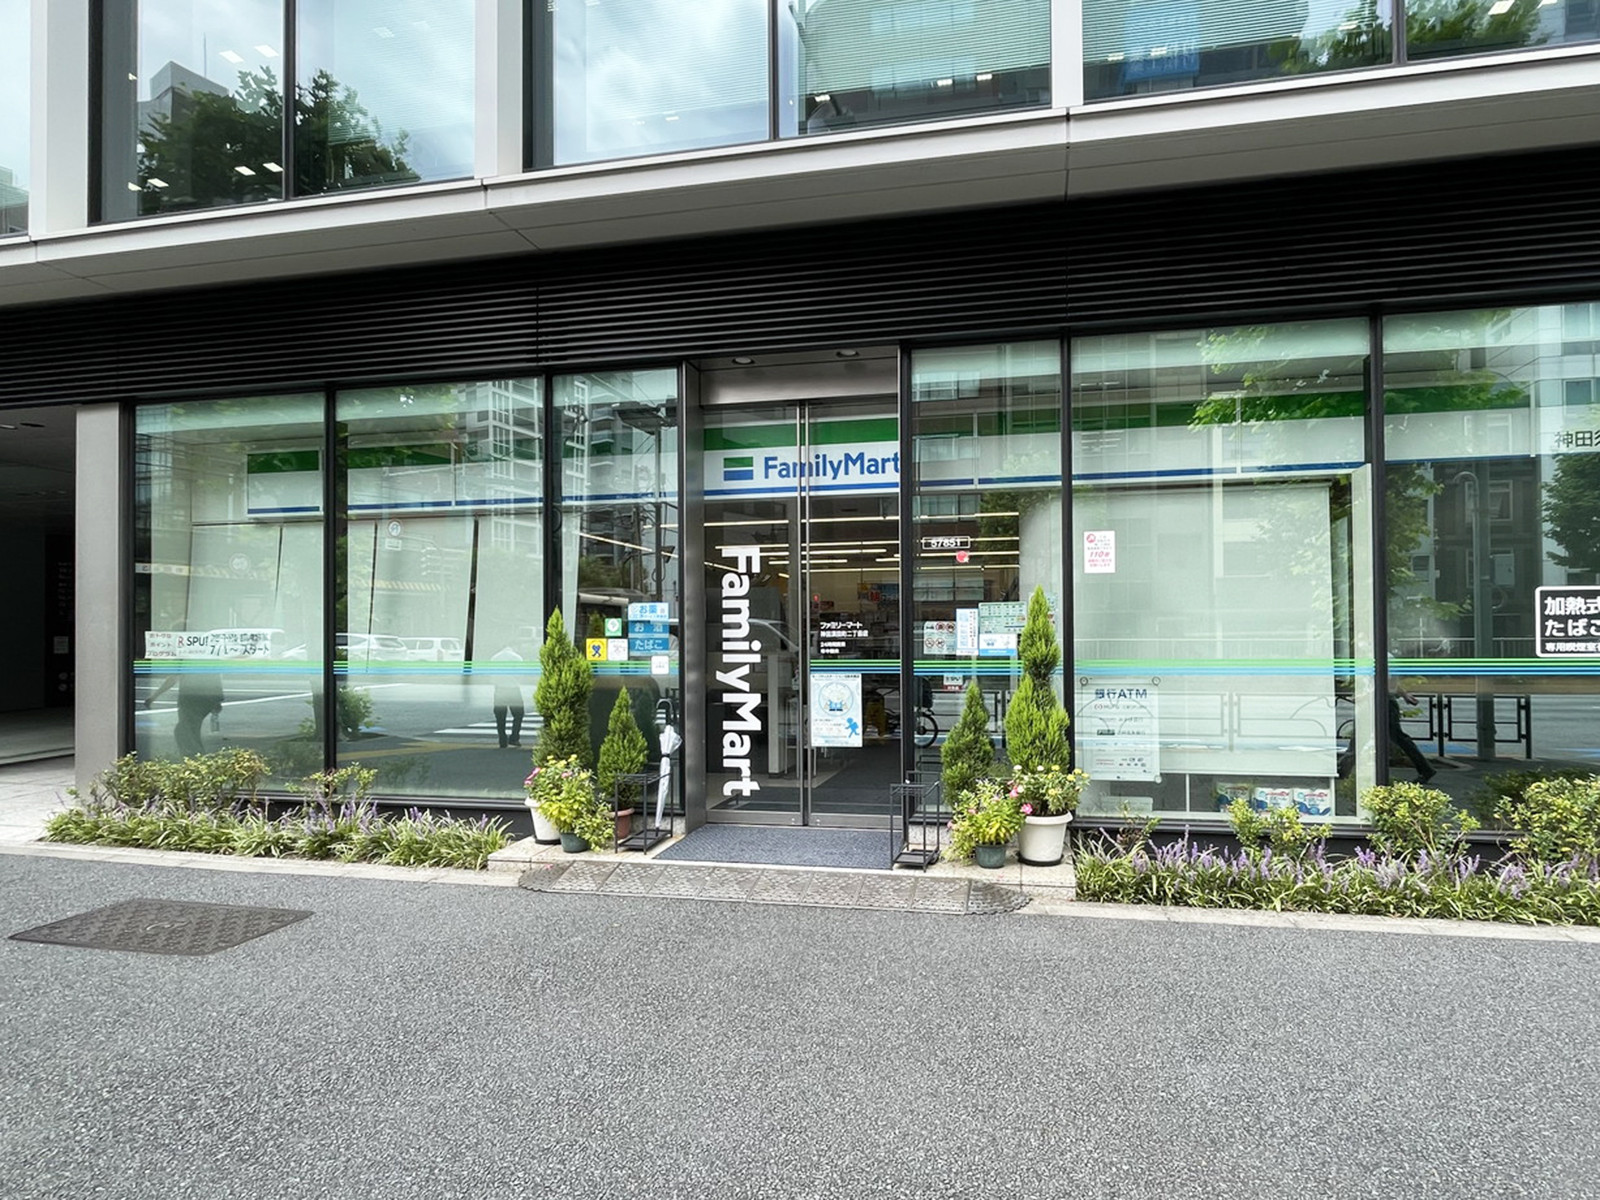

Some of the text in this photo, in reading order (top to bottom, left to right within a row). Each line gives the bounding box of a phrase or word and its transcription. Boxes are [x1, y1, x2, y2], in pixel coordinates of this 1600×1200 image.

[764, 452, 899, 480] FamilyMart
[1544, 596, 1600, 616] 加熱式
[634, 640, 663, 650] たばこ
[716, 546, 761, 796] FamilyMart
